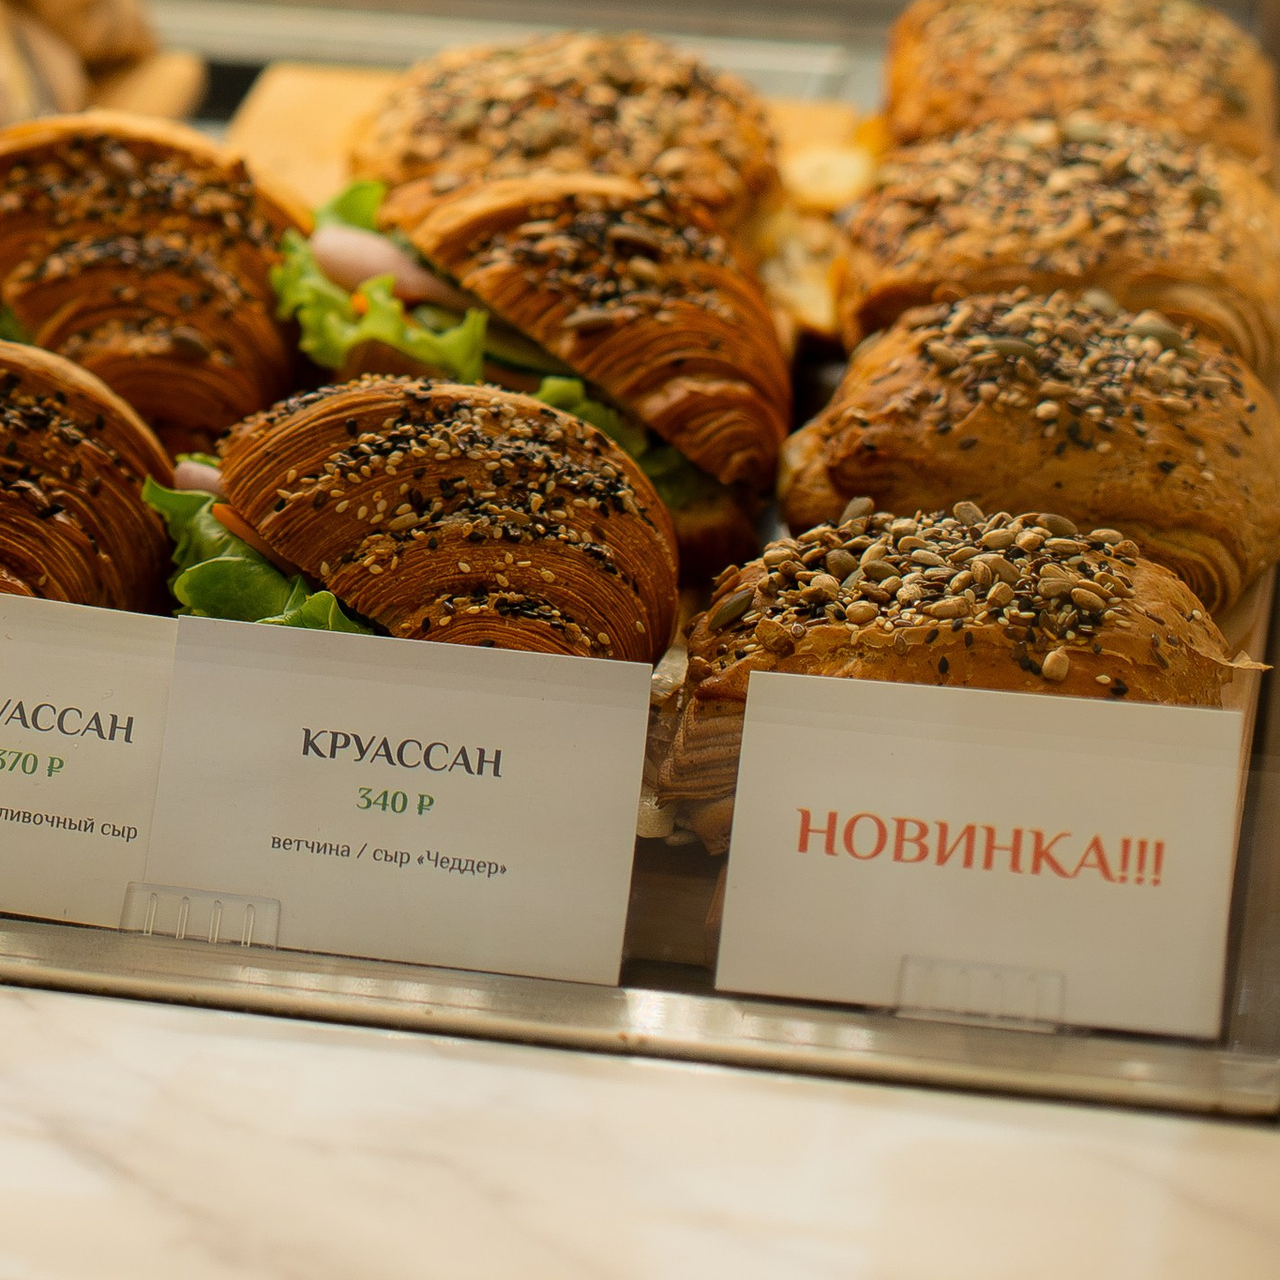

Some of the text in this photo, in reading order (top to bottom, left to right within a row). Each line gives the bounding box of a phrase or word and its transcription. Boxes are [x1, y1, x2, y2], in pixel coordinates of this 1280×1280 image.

[302, 728, 502, 777] КРУАССАН
[357, 787, 408, 814] 340
[101, 823, 137, 842] сыр
[796, 808, 1166, 887] НОВИНКА!!!
[271, 836, 350, 857] ветчина
[373, 848, 410, 868] сыр
[417, 850, 506, 878] «Чеддер»
